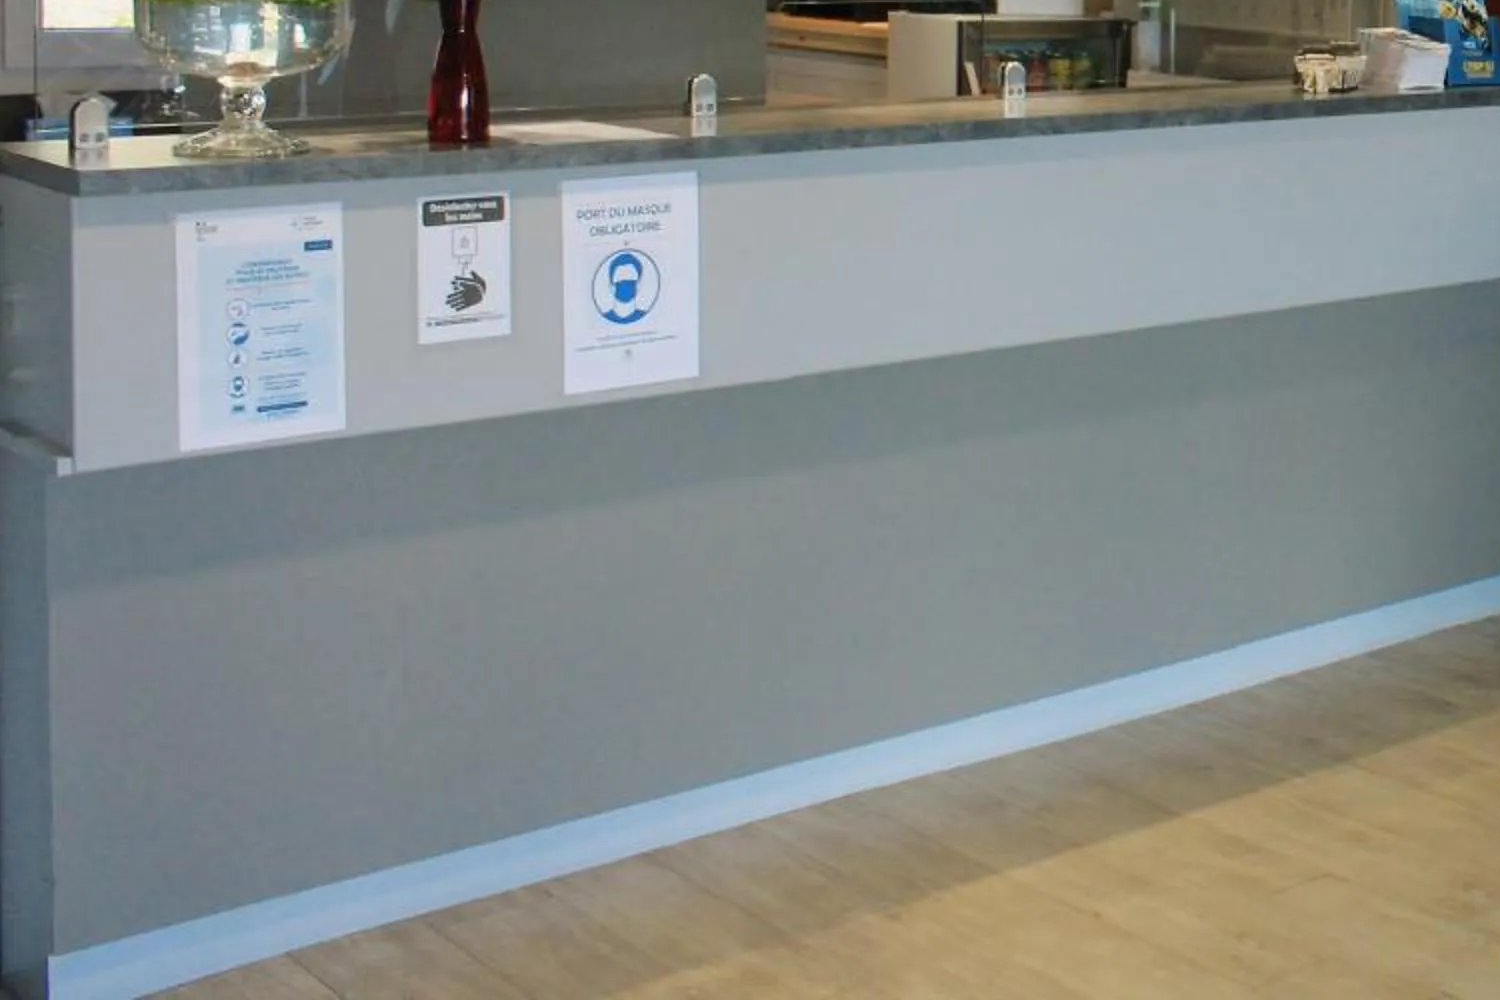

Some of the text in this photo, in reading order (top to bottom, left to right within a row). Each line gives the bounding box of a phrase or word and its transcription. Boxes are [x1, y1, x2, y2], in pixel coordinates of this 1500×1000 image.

[576, 202, 672, 221] PORT DU MASQUE
[589, 220, 662, 237] OBLIGATOIRE
